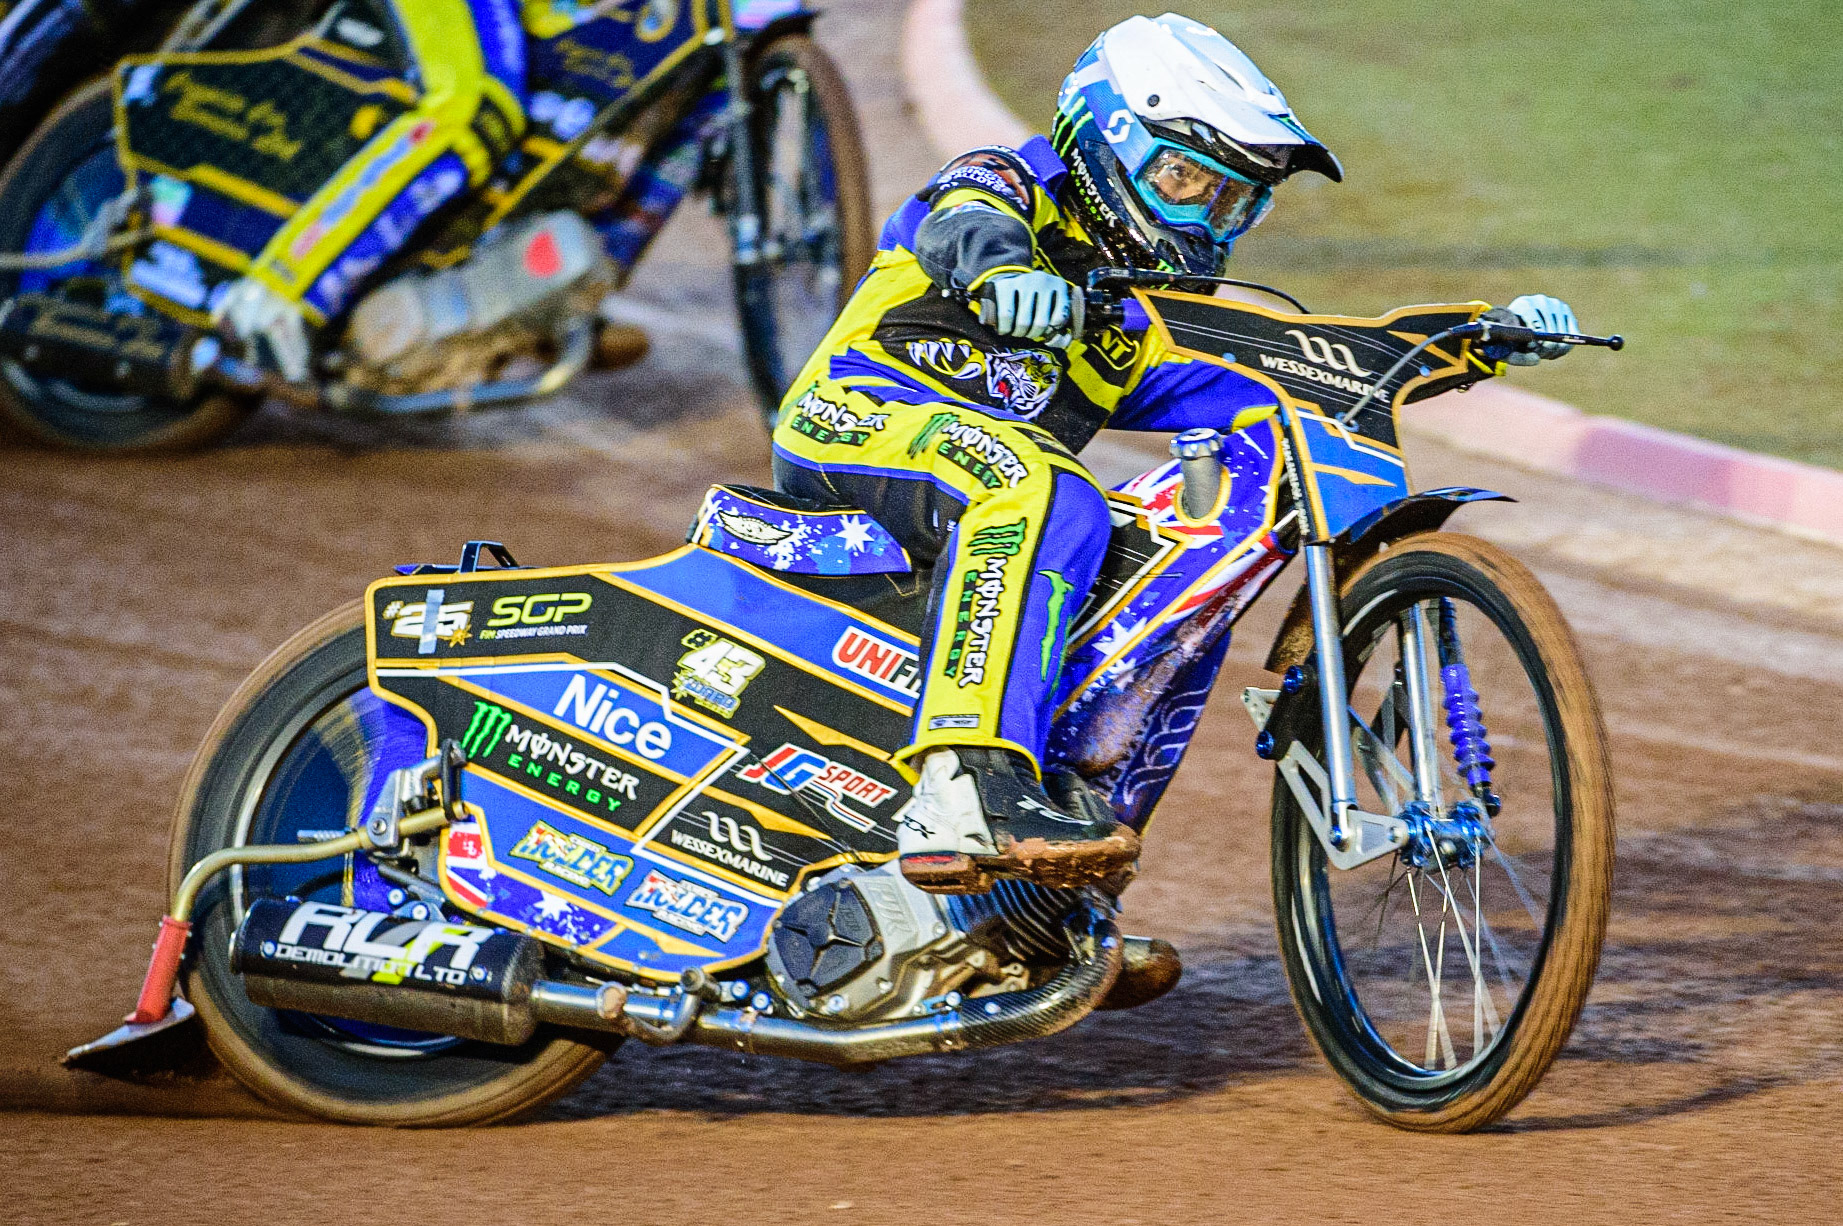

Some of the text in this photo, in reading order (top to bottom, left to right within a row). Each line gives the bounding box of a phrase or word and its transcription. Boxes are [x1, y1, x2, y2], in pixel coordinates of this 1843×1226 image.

[1071, 147, 1118, 228] MONSTER
[797, 391, 889, 432] MONSER
[486, 592, 593, 627] SGP
[495, 626, 538, 640] SPEEDWAY
[536, 624, 567, 637] GRAND
[565, 624, 588, 635] PRIX
[958, 556, 1008, 688] MONSTER
[553, 673, 673, 760] Nice
[505, 723, 641, 801] MONSTER
[507, 753, 622, 813] ENERGY
[817, 764, 893, 803] SPORT
[671, 828, 790, 888] WESSEXMARINE
[415, 965, 468, 987] LTD
